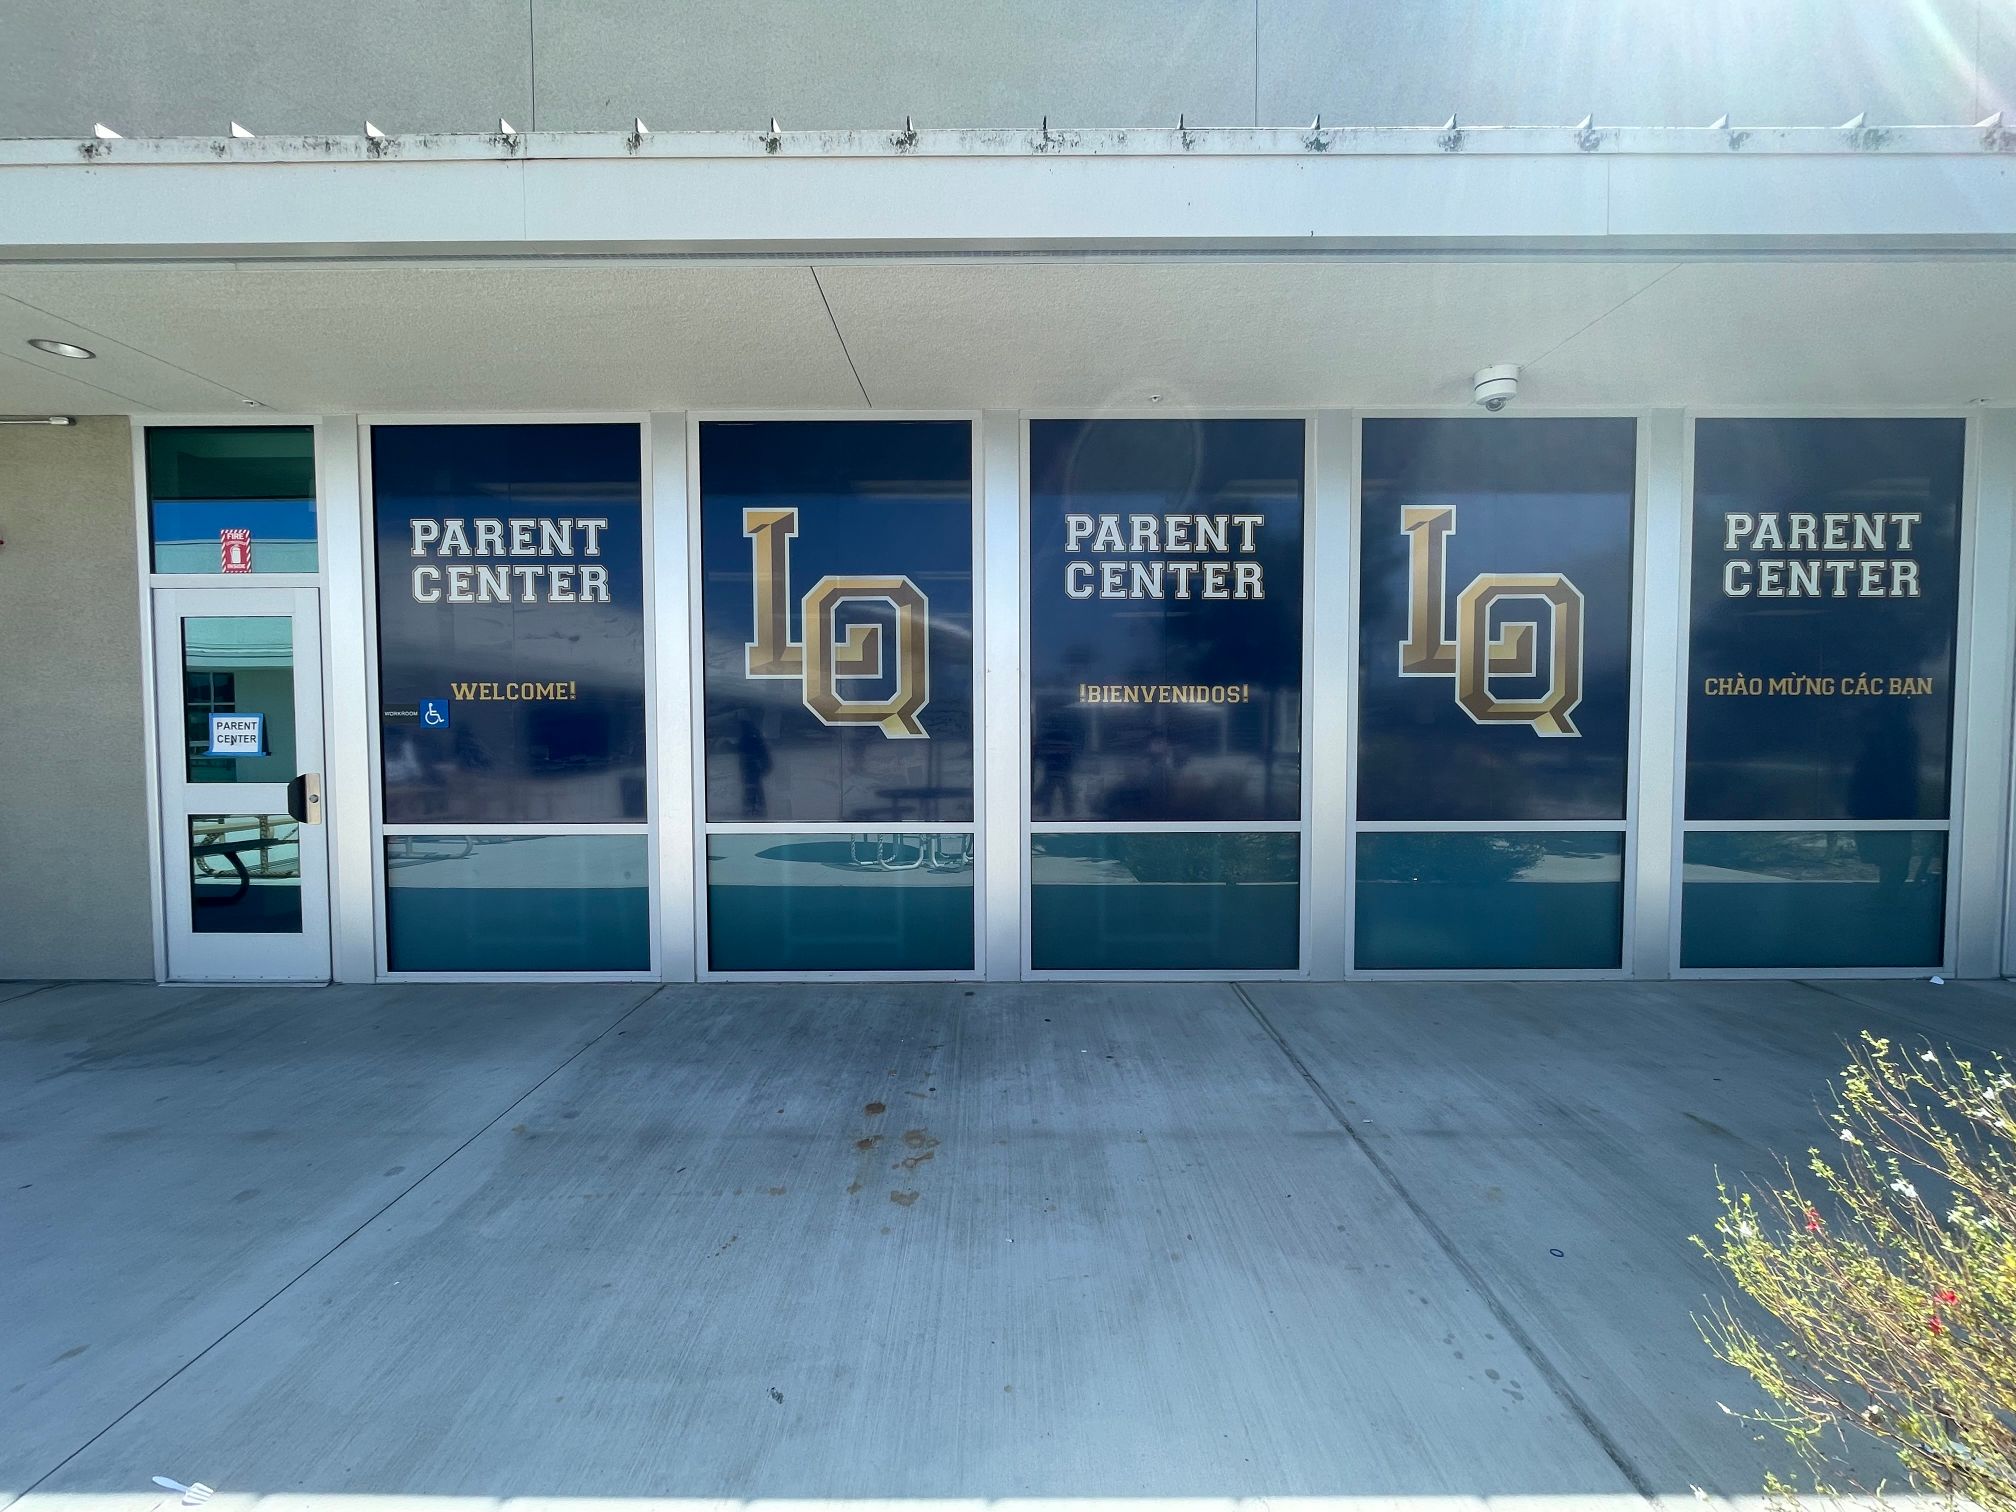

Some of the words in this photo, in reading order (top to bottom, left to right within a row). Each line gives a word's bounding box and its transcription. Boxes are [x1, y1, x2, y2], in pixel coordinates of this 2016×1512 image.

[226, 532, 245, 540] FIRE
[409, 517, 608, 557] PARENT
[1064, 513, 1265, 553] PARENT
[1724, 512, 1921, 551] PARENT
[411, 564, 611, 604] CENTER
[1064, 560, 1266, 600] CENTER
[1722, 559, 1921, 599] CENTER
[451, 680, 577, 701] WELCOME!
[1079, 683, 1249, 704] !BIENVENIDOS!
[1704, 672, 1763, 695] CHÀO
[1768, 672, 1835, 695] MỪNG
[1841, 672, 1883, 695] CÁC
[1888, 677, 1933, 699] BẠN
[216, 721, 257, 730] PARENT
[217, 735, 257, 744] CENTER
